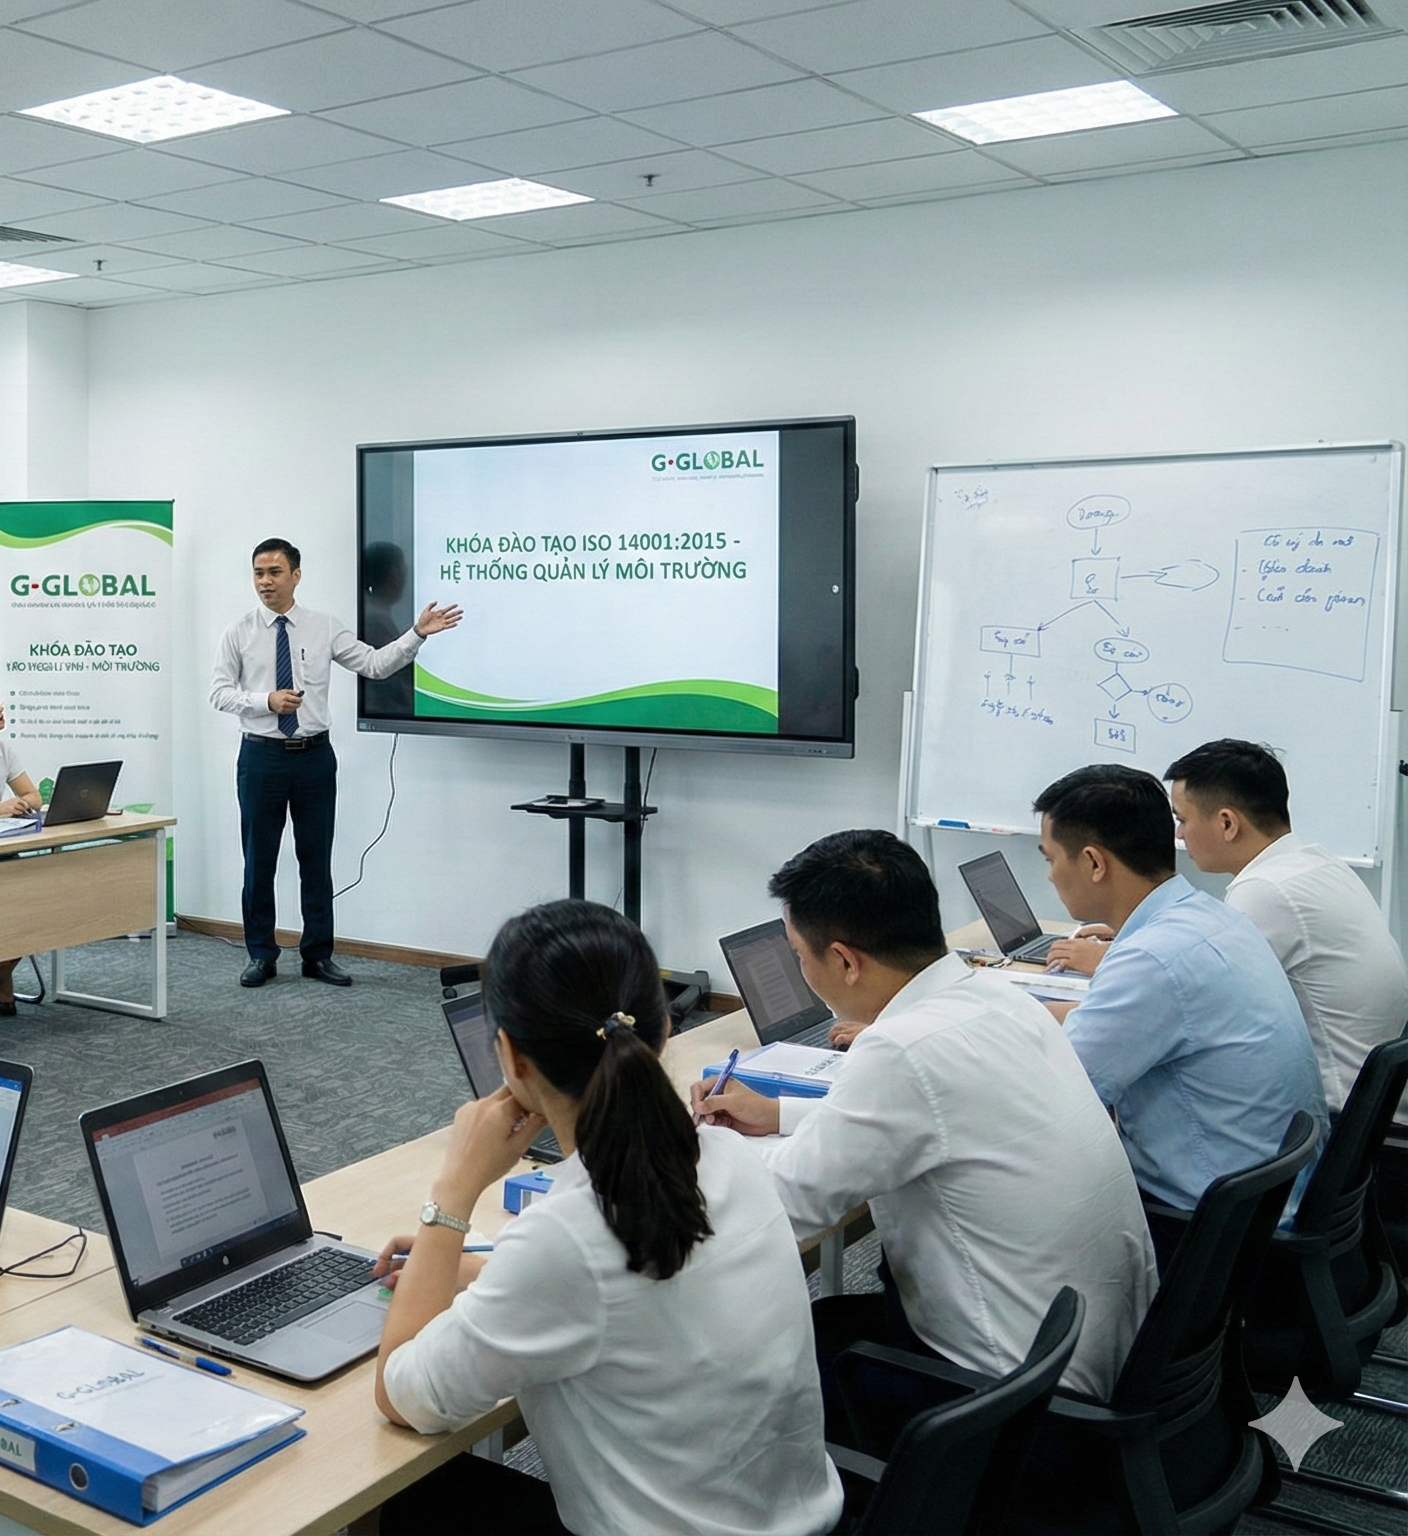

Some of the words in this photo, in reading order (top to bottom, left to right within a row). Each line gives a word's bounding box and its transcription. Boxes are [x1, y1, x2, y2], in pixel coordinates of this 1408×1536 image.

[446, 532, 494, 554] KHÓA
[498, 531, 536, 553] ĐÀO
[541, 534, 577, 556] TẠO
[582, 534, 612, 551] ISO
[618, 532, 727, 551] 14001:2015
[440, 560, 461, 584] HỆ
[466, 557, 528, 580] THỐNG
[533, 556, 585, 582] QUẢN
[592, 558, 610, 580] LÝ
[616, 557, 654, 580] MÔI
[660, 556, 747, 580] TRƯỜNG
[29, 640, 71, 657] KHÓA
[108, 644, 138, 660] TẠO
